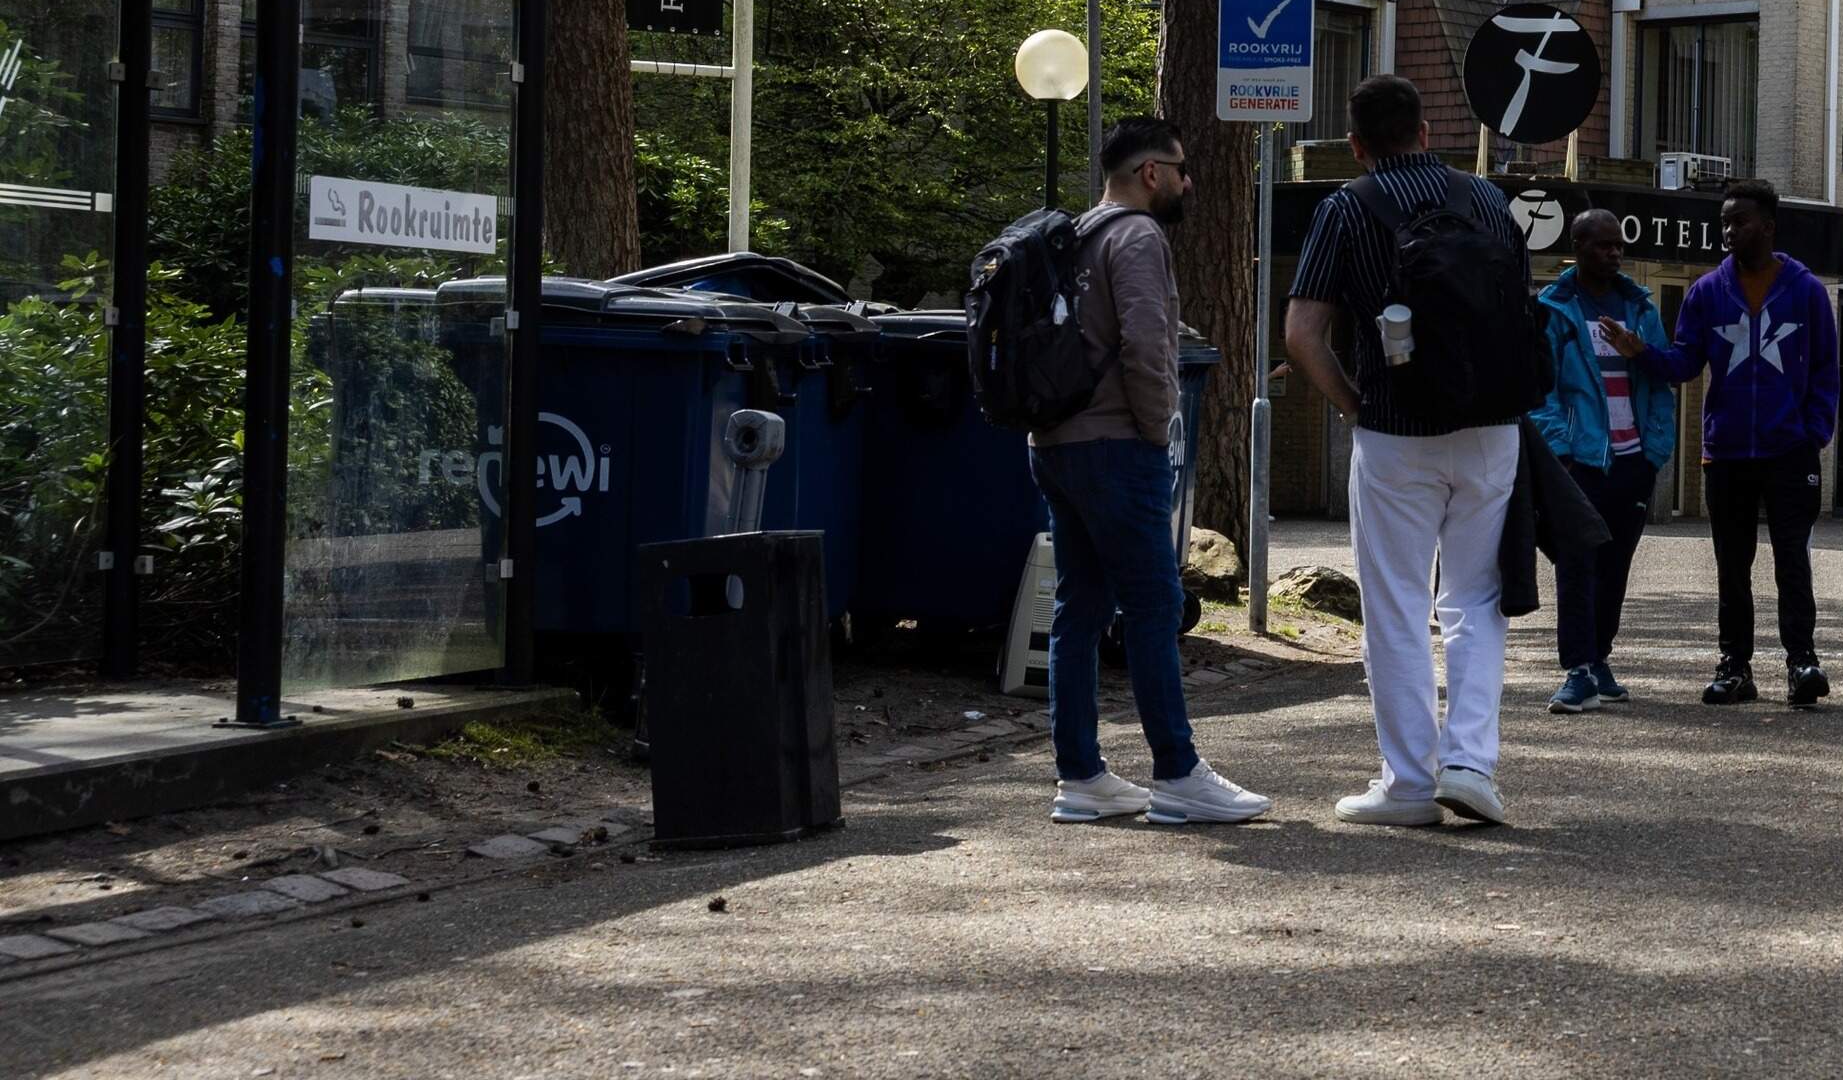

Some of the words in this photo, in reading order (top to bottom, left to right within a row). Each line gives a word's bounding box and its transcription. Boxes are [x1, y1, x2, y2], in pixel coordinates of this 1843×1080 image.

[1228, 43, 1302, 55] ROOKVRIJ
[1229, 84, 1299, 98] ROOKVRIJE
[1229, 97, 1299, 111] GENERATIE
[358, 190, 493, 245] Rookruimte
[1620, 214, 1730, 251] OTEL
